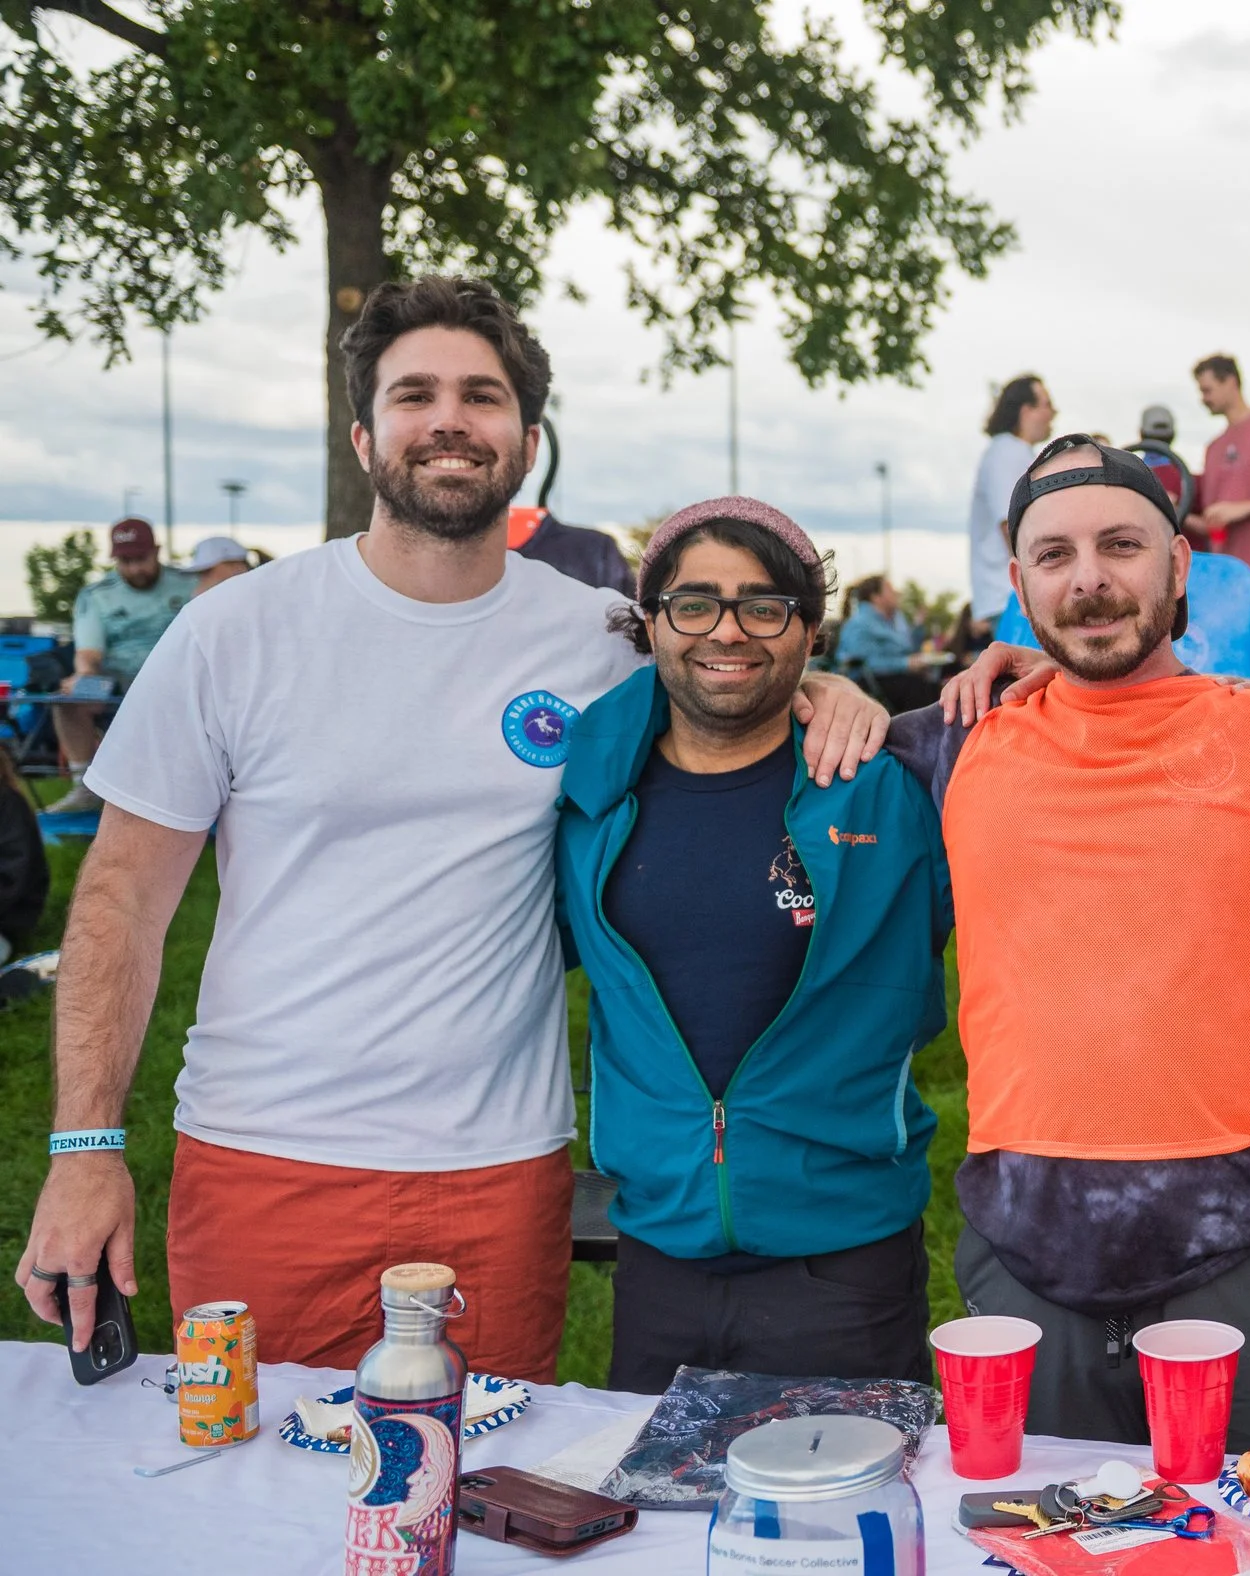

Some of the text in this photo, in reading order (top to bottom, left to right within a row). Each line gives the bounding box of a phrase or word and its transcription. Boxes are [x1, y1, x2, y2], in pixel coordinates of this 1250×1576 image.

[509, 694, 575, 719] BARE BONES
[759, 1554, 796, 1568] Soccer
[800, 1556, 859, 1569] Collective
